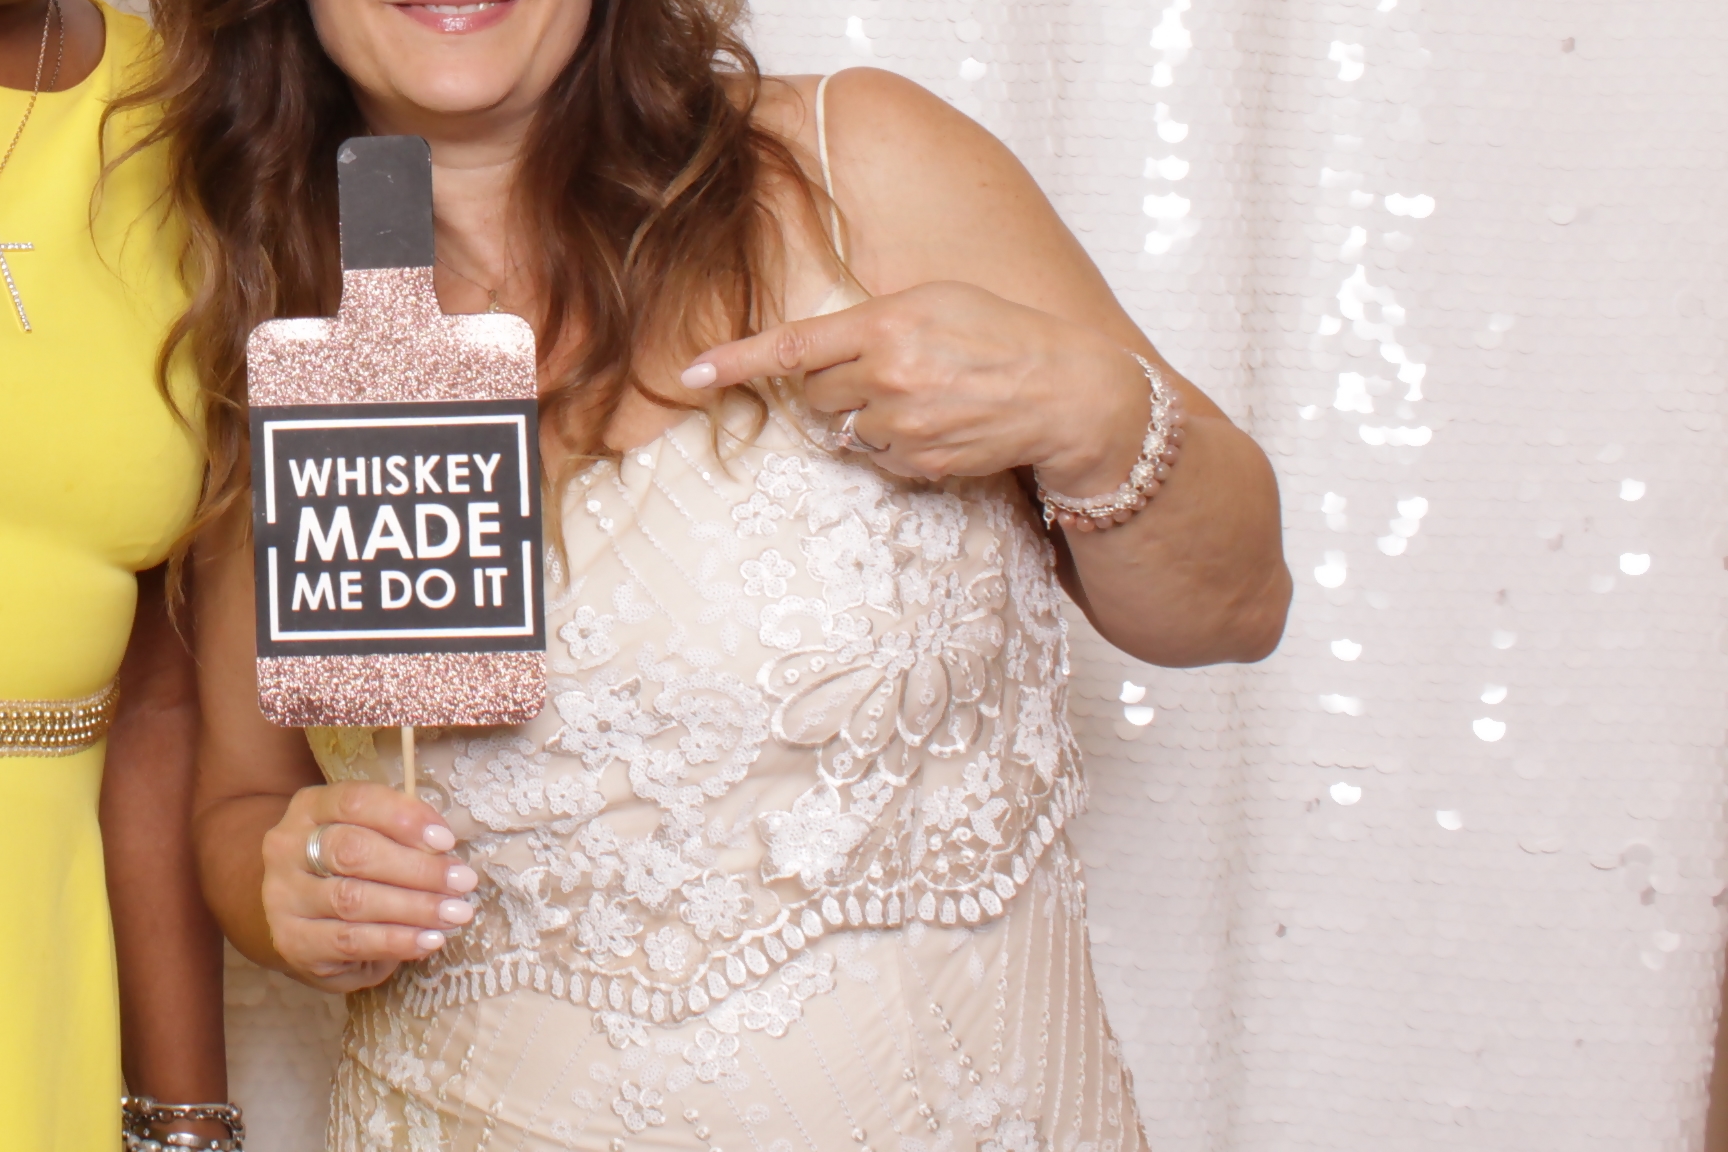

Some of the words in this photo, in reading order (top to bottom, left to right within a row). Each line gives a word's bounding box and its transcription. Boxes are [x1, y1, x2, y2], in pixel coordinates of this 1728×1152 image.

[289, 453, 501, 497] WHISKEY
[294, 502, 501, 562] MADE
[291, 571, 363, 611] ME
[380, 567, 456, 609] DO
[473, 567, 508, 607] IT
